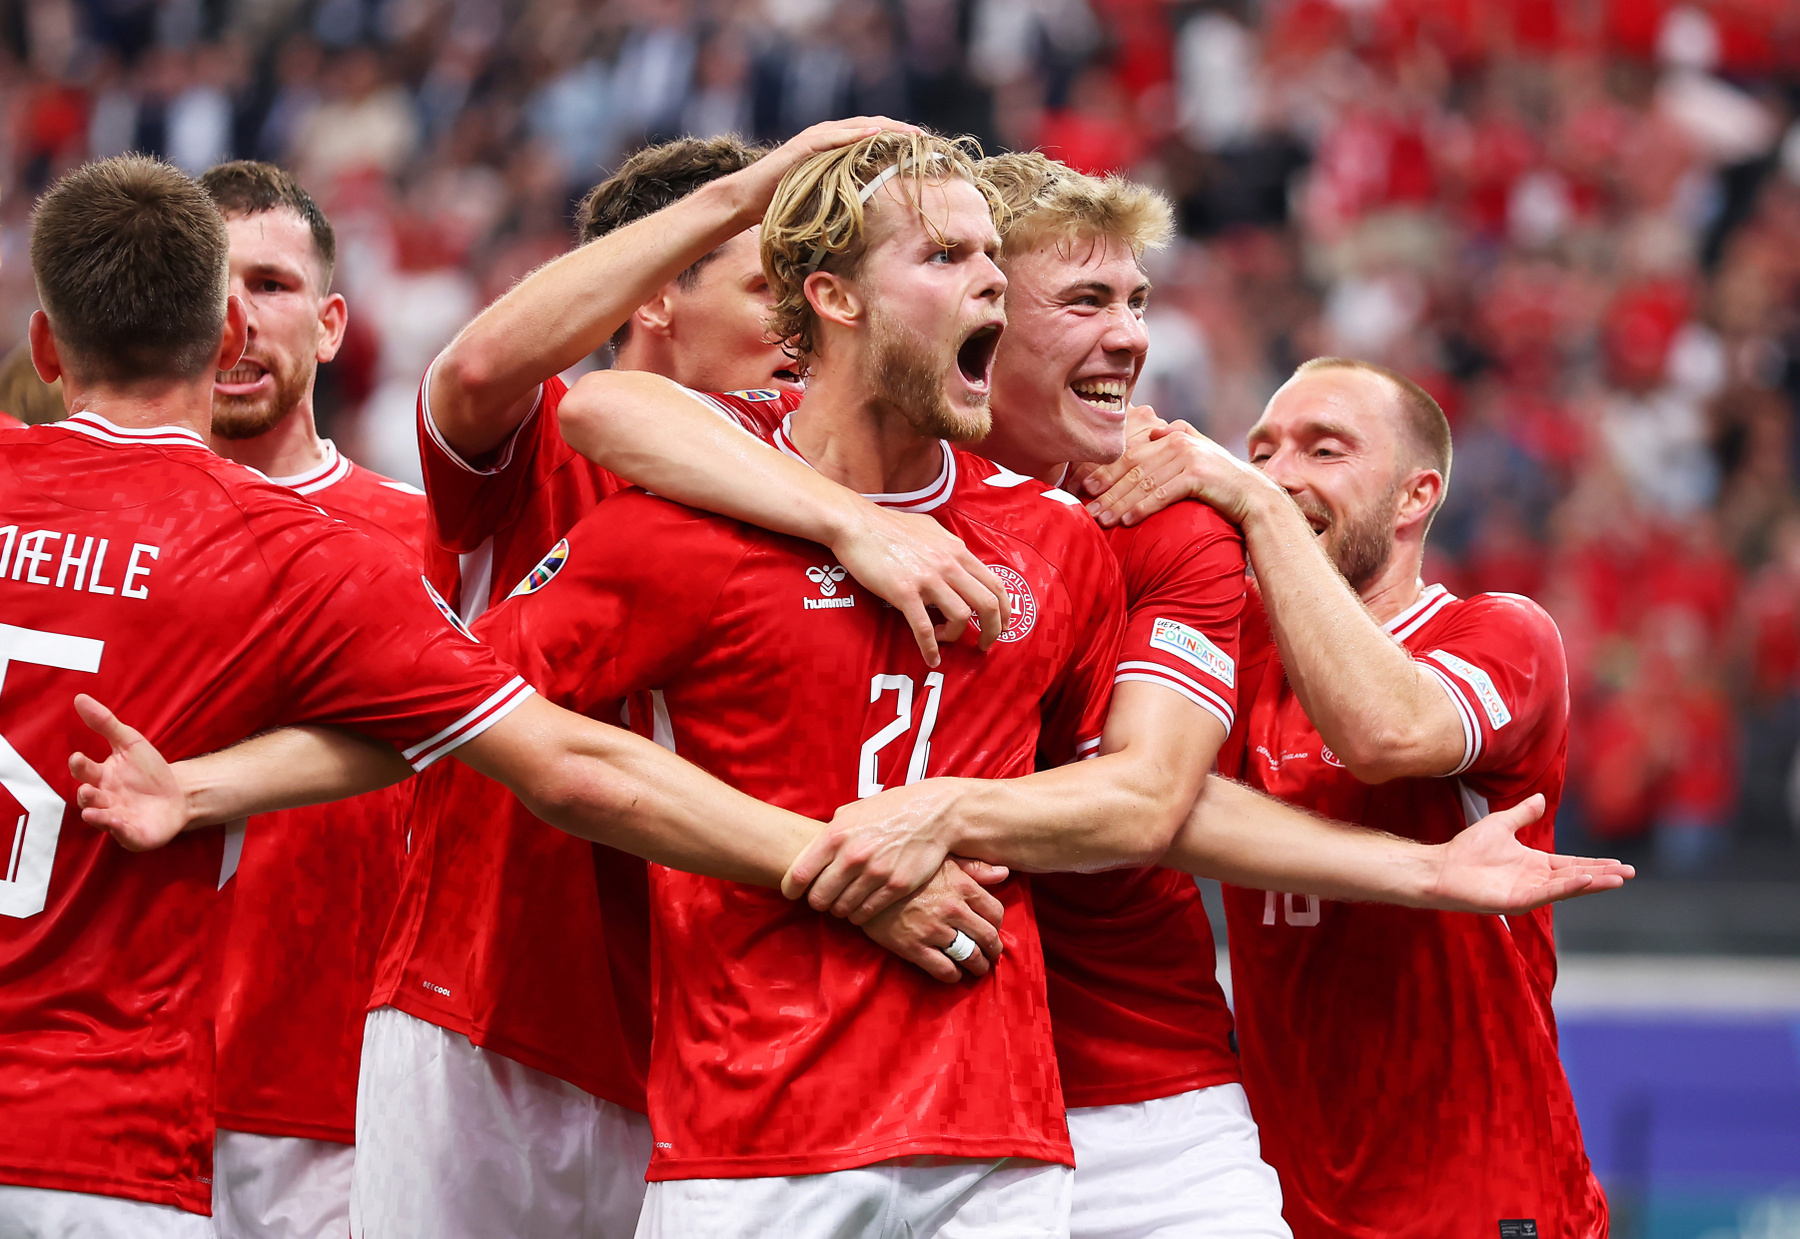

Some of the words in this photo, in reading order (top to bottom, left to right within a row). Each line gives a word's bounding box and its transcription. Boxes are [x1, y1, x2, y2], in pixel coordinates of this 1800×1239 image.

[803, 594, 855, 610] hummel
[1157, 620, 1181, 632] UEFA
[1155, 627, 1233, 679] FOUNDATION
[857, 671, 945, 799] 21
